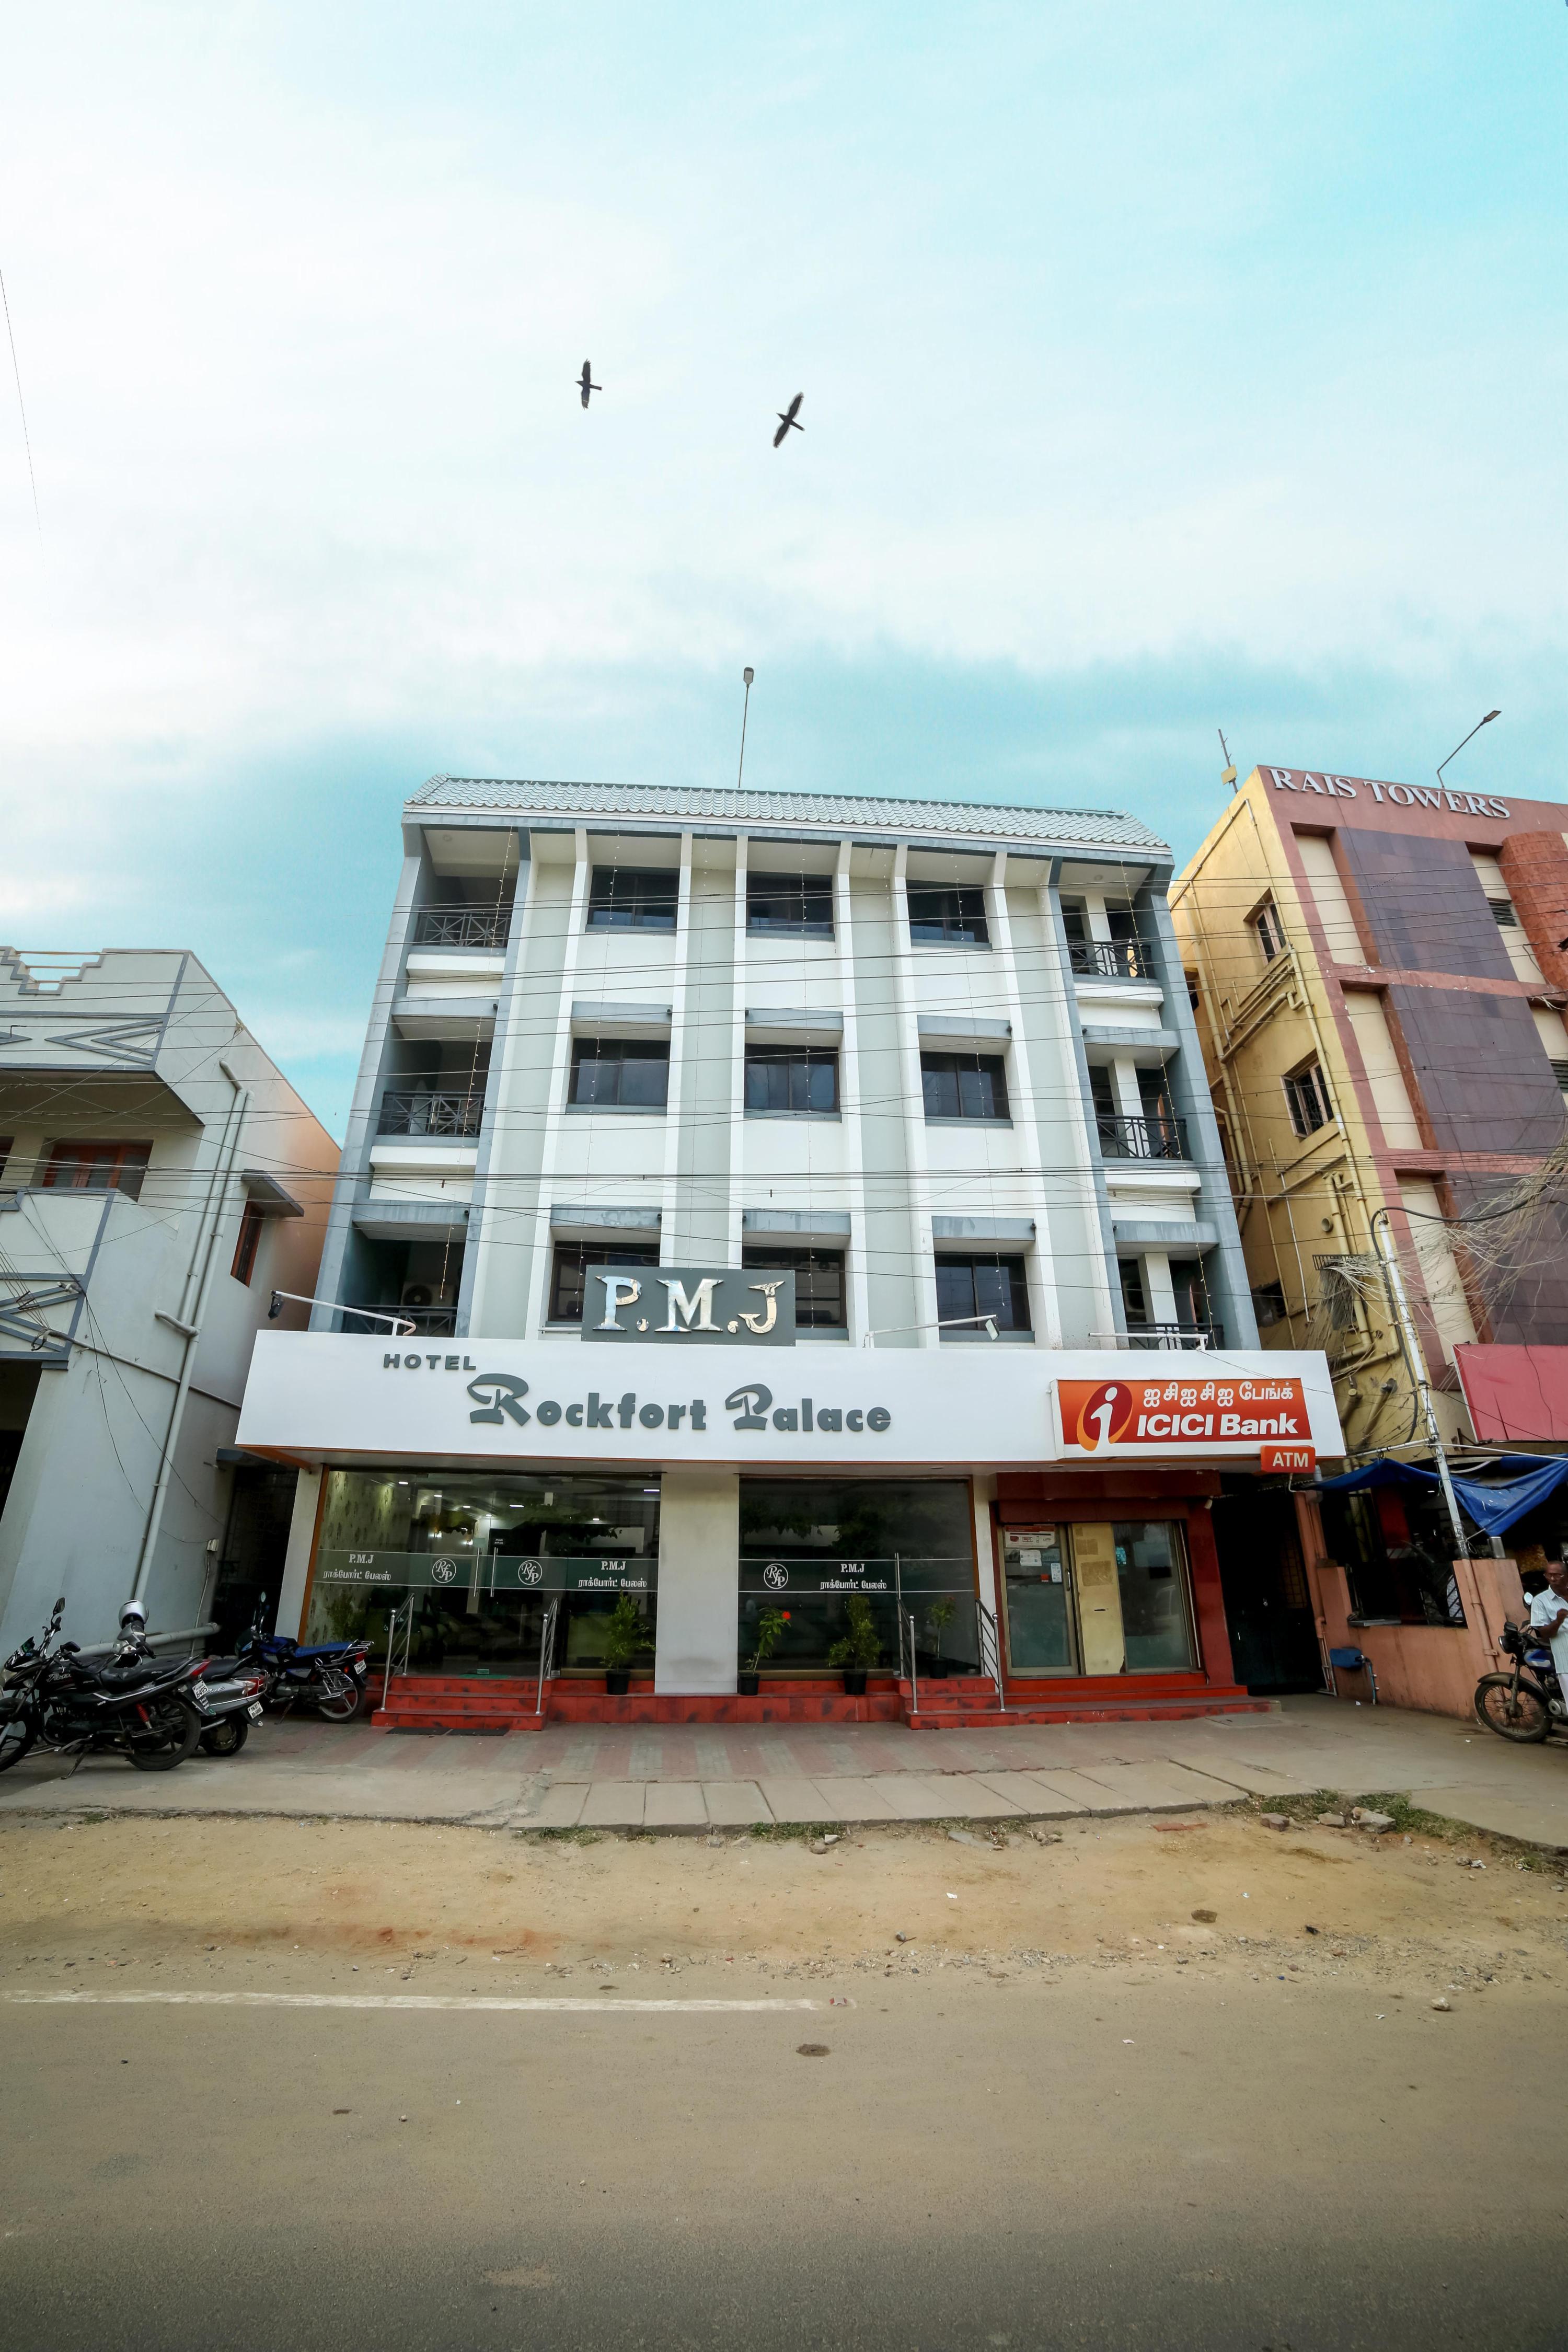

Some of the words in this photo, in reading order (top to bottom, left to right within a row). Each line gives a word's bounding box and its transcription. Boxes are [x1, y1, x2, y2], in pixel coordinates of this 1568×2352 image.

[1267, 768, 1357, 799] RAIS
[1364, 781, 1511, 819] TOWERS
[592, 1275, 785, 1334] P.M.J
[383, 1353, 477, 1370] HOTEL
[466, 1373, 707, 1430] Rockfort
[725, 1383, 891, 1432] Palace
[1137, 1414, 1214, 1436] ICICI
[1220, 1413, 1298, 1436] Bank
[1272, 1452, 1309, 1468] ATM
[349, 1554, 374, 1564] P.M.J
[601, 1561, 627, 1571] P.M.J
[840, 1563, 865, 1573] P.M.J
[196, 1686, 207, 1698] 6495
